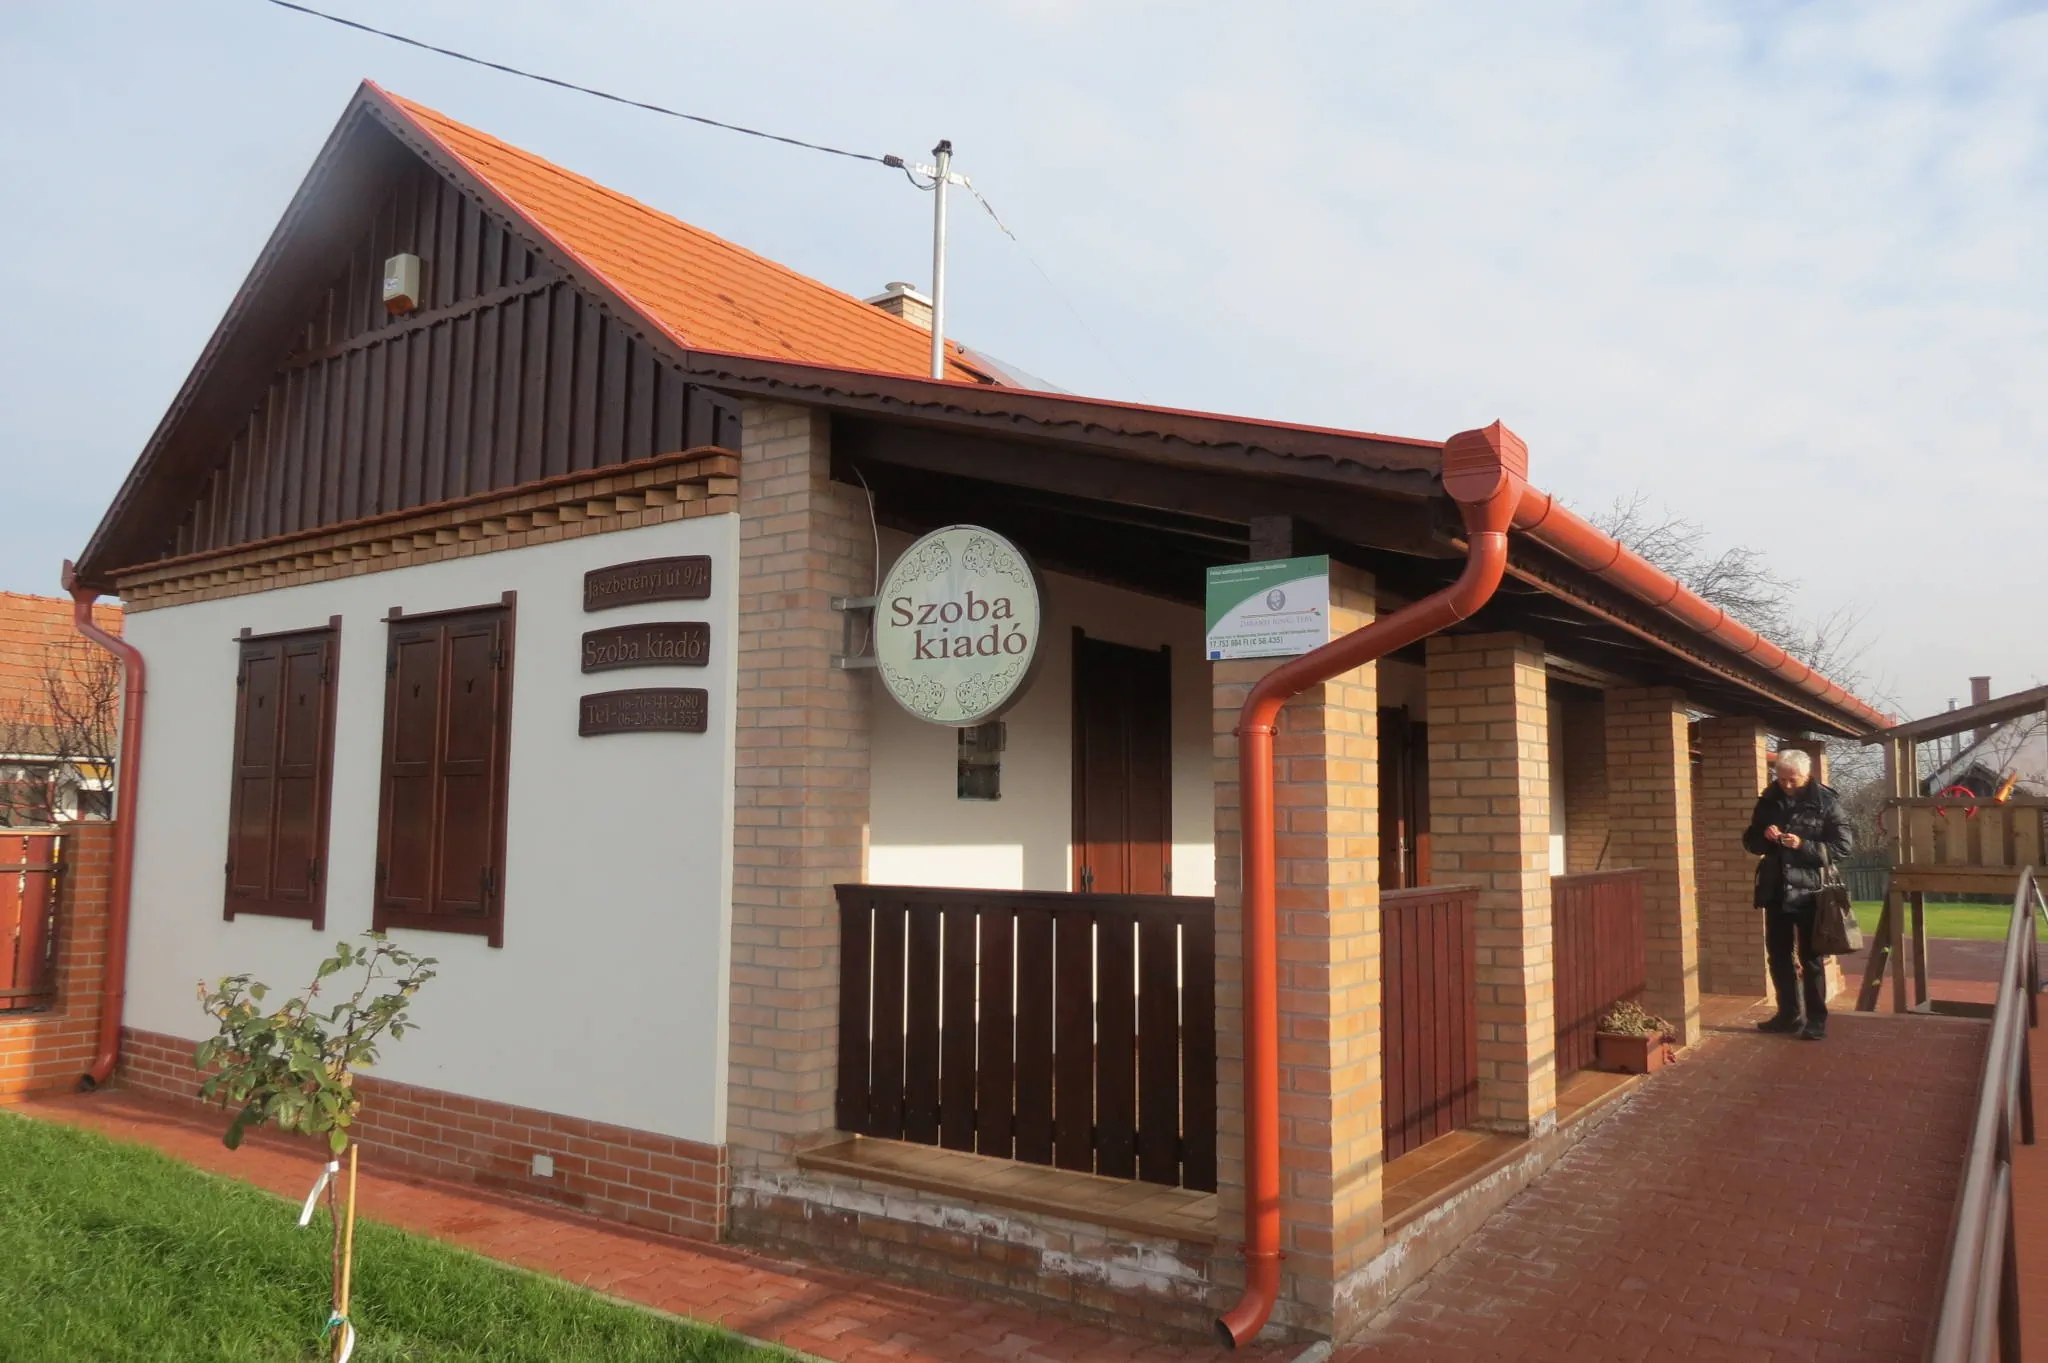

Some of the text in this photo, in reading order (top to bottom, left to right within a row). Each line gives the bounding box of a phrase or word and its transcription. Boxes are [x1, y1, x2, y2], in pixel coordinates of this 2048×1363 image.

[666, 567, 680, 585] út
[891, 591, 1015, 628] Szoba
[585, 630, 701, 666] Szoba kiadó
[912, 623, 1027, 660] kiadó
